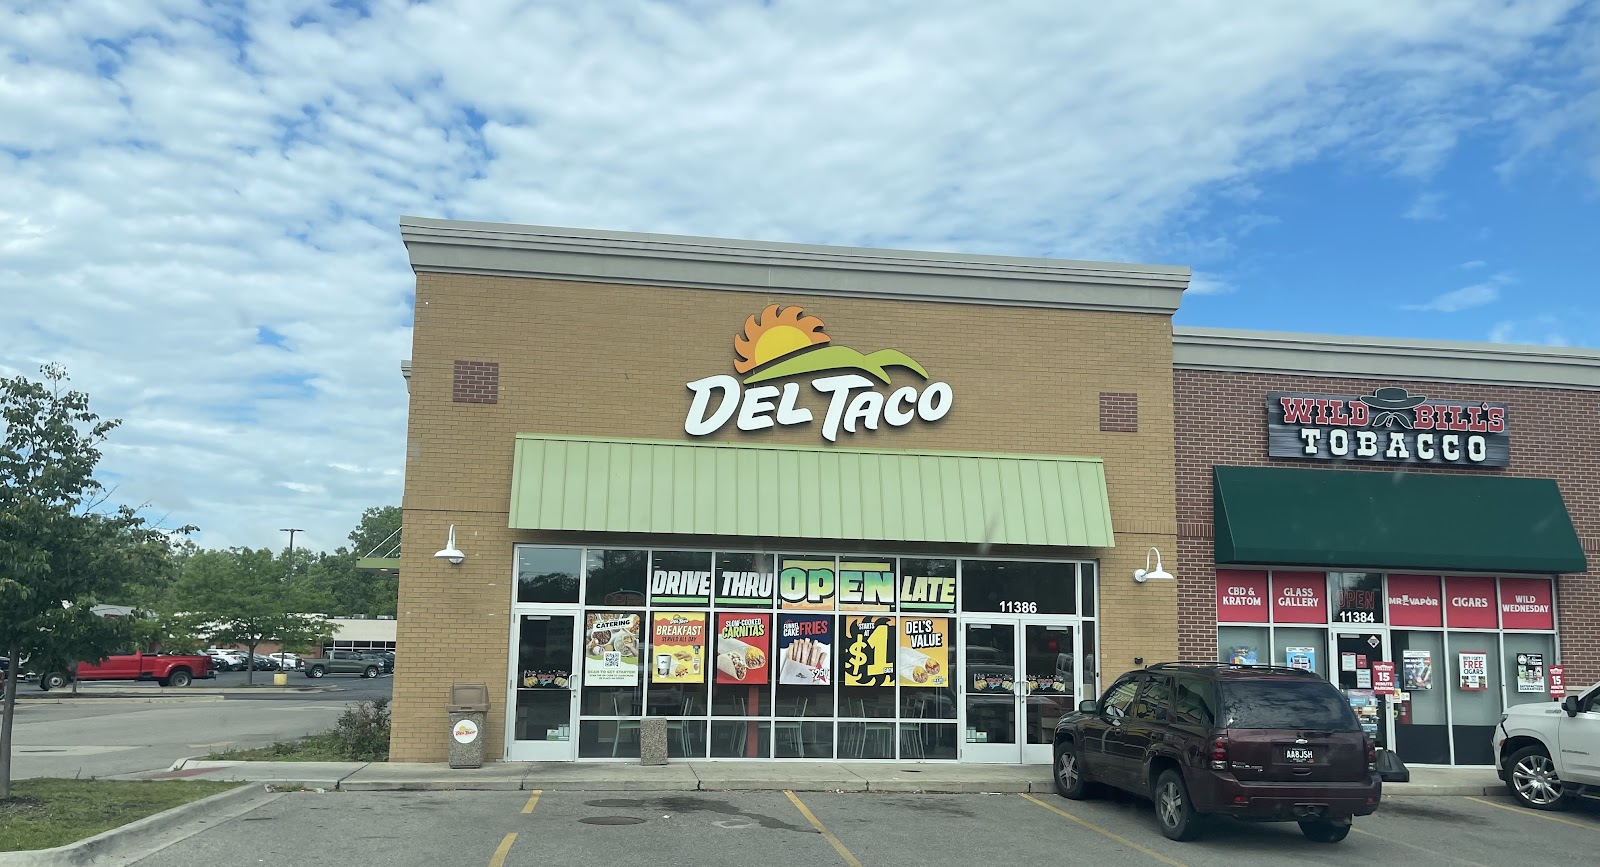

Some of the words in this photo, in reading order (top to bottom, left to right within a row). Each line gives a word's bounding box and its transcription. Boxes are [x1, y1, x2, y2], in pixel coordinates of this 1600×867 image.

[684, 374, 813, 436] DEL
[811, 374, 953, 442] TACO
[1280, 397, 1370, 426] WILD
[1413, 402, 1505, 432] BILL'S
[1301, 428, 1487, 462] TOBACCO
[652, 570, 711, 595] DRIVE
[721, 571, 773, 597] THRU
[780, 568, 895, 602] OPEN
[900, 576, 956, 603] LATE
[1228, 587, 1246, 596] CBD
[1248, 587, 1255, 596] &
[1283, 587, 1313, 597] GLASS
[1223, 597, 1261, 606] KRATOM
[1278, 597, 1319, 607] GALLERY
[1337, 590, 1375, 608] OPEN
[1389, 597, 1402, 605] MR
[1452, 597, 1488, 608] CIGARS
[1515, 595, 1536, 604] WILD
[1000, 601, 1038, 613] 11386
[1502, 604, 1549, 613] WEDNESDAY
[1340, 611, 1375, 623] 11384
[596, 619, 631, 629] CATERING
[725, 618, 761, 628] SLOW-COOKED
[783, 622, 799, 630] FUNNEL
[858, 622, 875, 630] STARTS
[905, 620, 932, 635] DEL'S
[656, 625, 702, 636] BREAKFAST
[722, 625, 765, 639] CARNITAS
[783, 628, 799, 637] CAKE
[799, 620, 828, 636] FRIES
[910, 633, 942, 648] VALUE
[848, 624, 893, 676] $1
[1464, 660, 1483, 668] FREE
[1377, 672, 1390, 681] 15
[1552, 675, 1561, 685] 15
